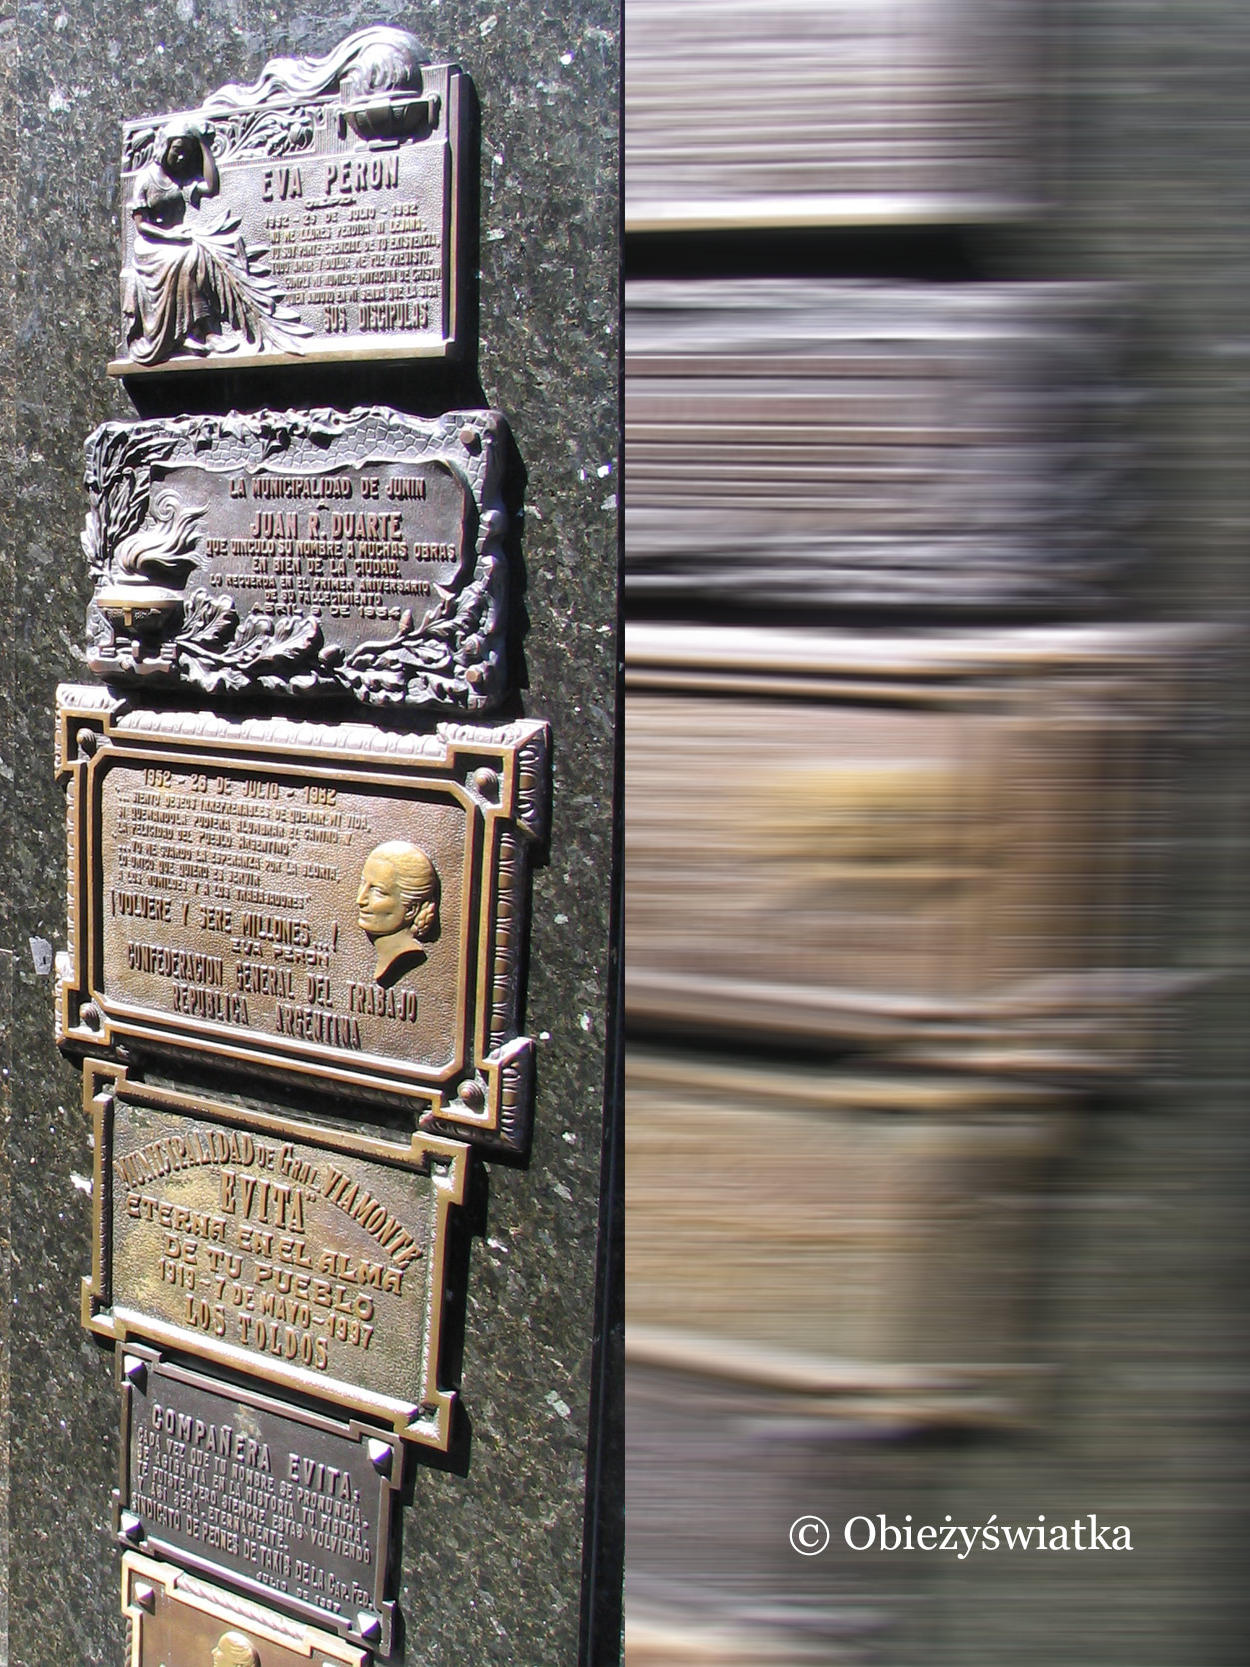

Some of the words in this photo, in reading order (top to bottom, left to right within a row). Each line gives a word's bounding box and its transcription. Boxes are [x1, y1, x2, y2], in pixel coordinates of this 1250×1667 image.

[262, 167, 302, 202] EVA
[325, 156, 399, 195] PERON
[325, 212, 338, 223] DE
[324, 306, 348, 333] SUS
[229, 477, 246, 499] LA
[252, 477, 352, 500] MUNICIPALIDAD
[361, 477, 379, 499] DE
[385, 476, 426, 500] JUNIN
[250, 511, 298, 540] JUAN
[308, 511, 326, 540] R.
[332, 511, 402, 541] DUARTE
[206, 538, 227, 558] QUE
[231, 539, 275, 556] VINCULO
[277, 540, 293, 557] SU
[295, 541, 342, 559] NOMBRE
[347, 541, 356, 559] A
[359, 541, 408, 560] MUCHAS
[414, 542, 457, 562] OBRAS
[253, 558, 267, 574] EN
[273, 559, 300, 575] BIEN
[307, 559, 323, 575] DE
[330, 559, 346, 576] LA
[210, 574, 222, 587] LO
[226, 575, 277, 589] RECUERDA
[281, 576, 293, 589] EN
[297, 577, 310, 589] EL
[313, 577, 354, 592] PRIMER
[359, 579, 430, 596] ANIVERSARIO
[265, 589, 277, 601] DE
[281, 590, 294, 602] SU
[299, 591, 383, 607] FALLECIMIENTO
[251, 602, 302, 617] ABRIL
[331, 605, 351, 618] DE
[358, 606, 400, 620] 1954
[143, 768, 172, 789] 1952
[191, 772, 208, 793] 26
[217, 775, 233, 796] DE
[241, 778, 279, 801] JULIO
[303, 784, 338, 807] 1982
[179, 900, 190, 927] Y
[199, 904, 232, 933] SERE
[231, 938, 263, 958] EVA
[273, 944, 330, 968] PERON
[127, 941, 223, 987] CONFEDERACION
[236, 960, 295, 1000] GENERAL
[307, 972, 333, 1007] DEL
[346, 979, 418, 1023] TRABAJO
[172, 981, 250, 1026] REPUBLICA
[276, 1002, 362, 1049] ARGENTINA
[113, 1130, 255, 1190] MUNICIPALIDAD
[258, 1144, 275, 1171] DE
[323, 1163, 423, 1271] VIAMONTE
[126, 1192, 227, 1244] ETERNA
[237, 1224, 273, 1259] EN
[277, 1236, 314, 1269] EL
[318, 1248, 404, 1297] ALMA
[165, 1233, 198, 1265] DE
[206, 1245, 244, 1279] TU
[254, 1261, 375, 1321] PUEBLO
[233, 1282, 255, 1312] DE
[186, 1294, 226, 1336] LOS
[238, 1312, 329, 1370] TOLDOS
[152, 1404, 272, 1474] COMPAÑERA
[137, 1427, 161, 1451] CADA
[166, 1434, 185, 1459] VEZ
[190, 1446, 210, 1468] QUE
[214, 1456, 227, 1475] TU
[232, 1462, 274, 1494] NOMBRE
[280, 1481, 294, 1502] SE
[137, 1443, 150, 1462] SE
[156, 1451, 207, 1485] AGIGANTA
[213, 1474, 227, 1492] EN
[230, 1480, 242, 1499] LA
[246, 1486, 295, 1519] HISTORIA
[302, 1506, 316, 1526] TU
[137, 1475, 144, 1491] Y
[151, 1482, 168, 1502] ASI
[137, 1460, 149, 1477] TE
[193, 1482, 217, 1505] PERO
[222, 1494, 265, 1524] SIEMPRE
[272, 1514, 304, 1540] ESTAS
[310, 1528, 371, 1564] VOLVIENDO
[131, 1491, 181, 1531] SINDICATO
[186, 1514, 199, 1540] DE
[202, 1521, 239, 1555] PEONES
[244, 1538, 258, 1564] DE
[260, 1545, 291, 1577] TAXIS
[295, 1559, 310, 1585] DE
[311, 1565, 325, 1591] LA
[256, 1571, 288, 1592] JULIO
[296, 1587, 309, 1601] DE
